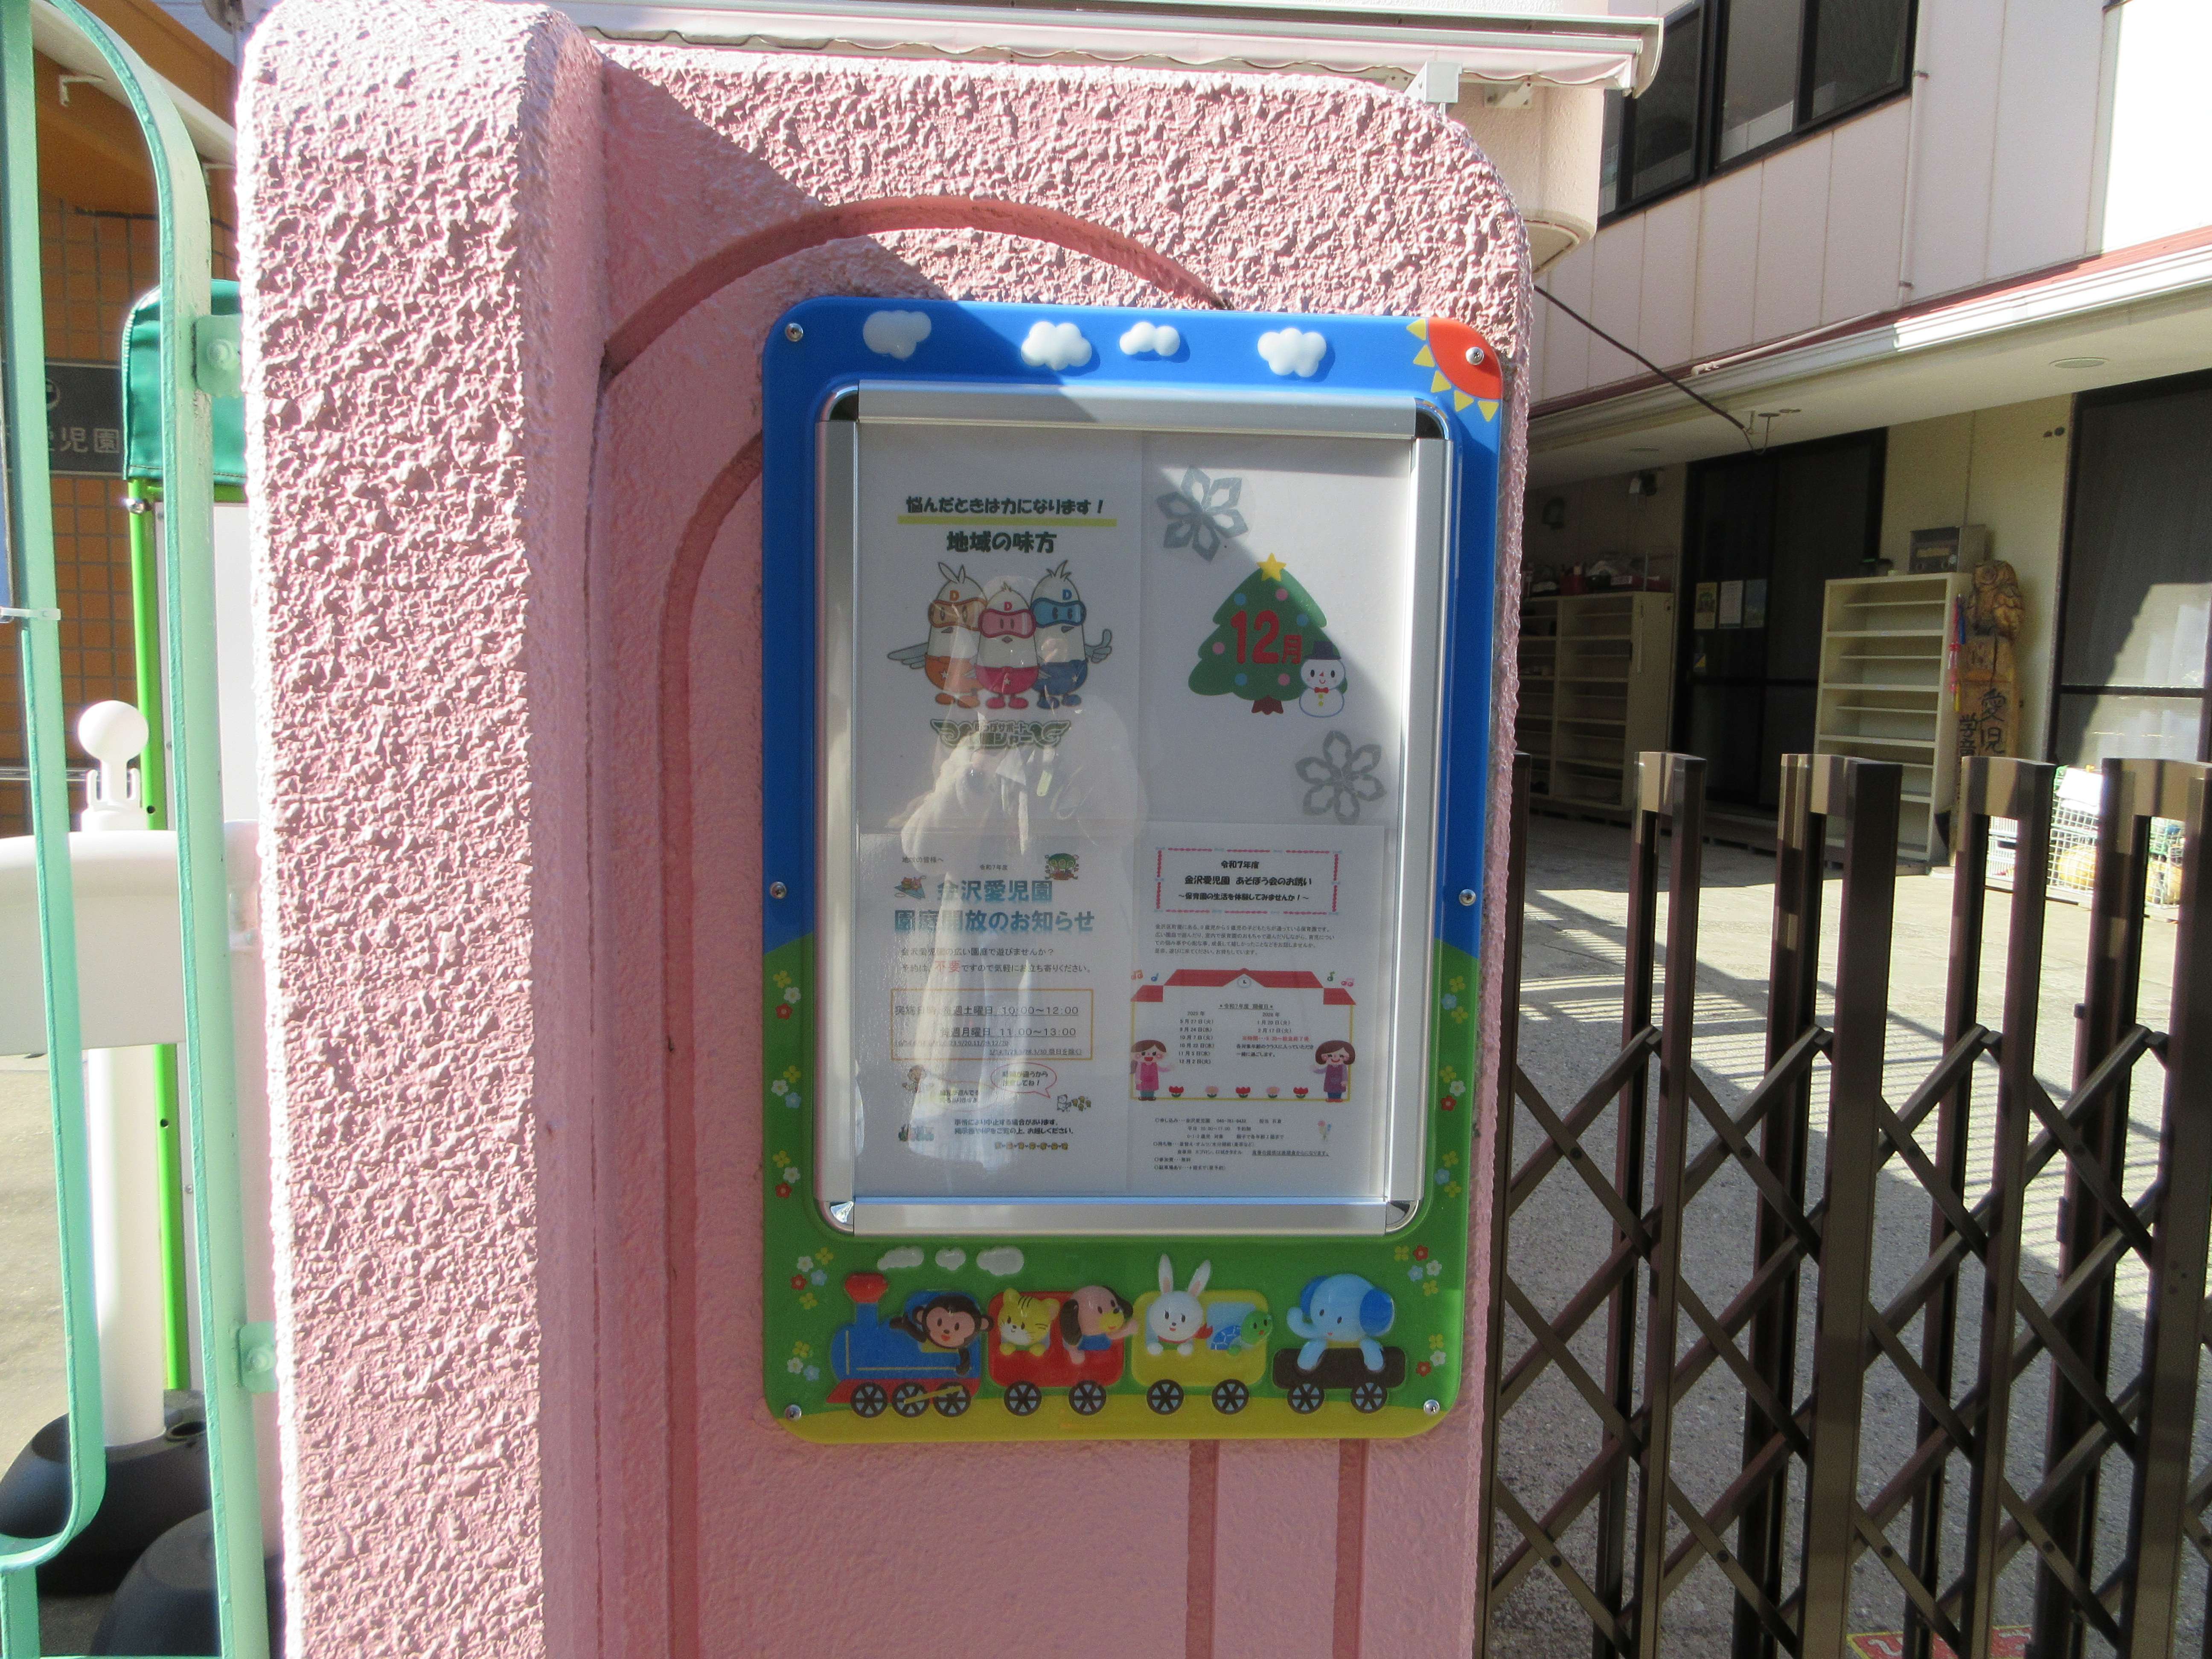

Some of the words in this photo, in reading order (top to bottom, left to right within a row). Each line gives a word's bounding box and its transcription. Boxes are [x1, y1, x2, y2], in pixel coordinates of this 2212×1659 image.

[47, 428, 119, 454] 児園
[947, 531, 1057, 553] 地域の味方
[950, 591, 960, 601] D
[1062, 589, 1072, 600] D
[1004, 602, 1013, 611] D
[1231, 610, 1302, 664] 12月
[1221, 860, 1260, 869] 令和7年度
[1185, 875, 1230, 886] 金沢愛児園
[1236, 876, 1312, 887] あそぼう会のお誘い
[937, 880, 1053, 902] 金沢愛児園
[894, 910, 1094, 932] 園庭開放のお知らせ
